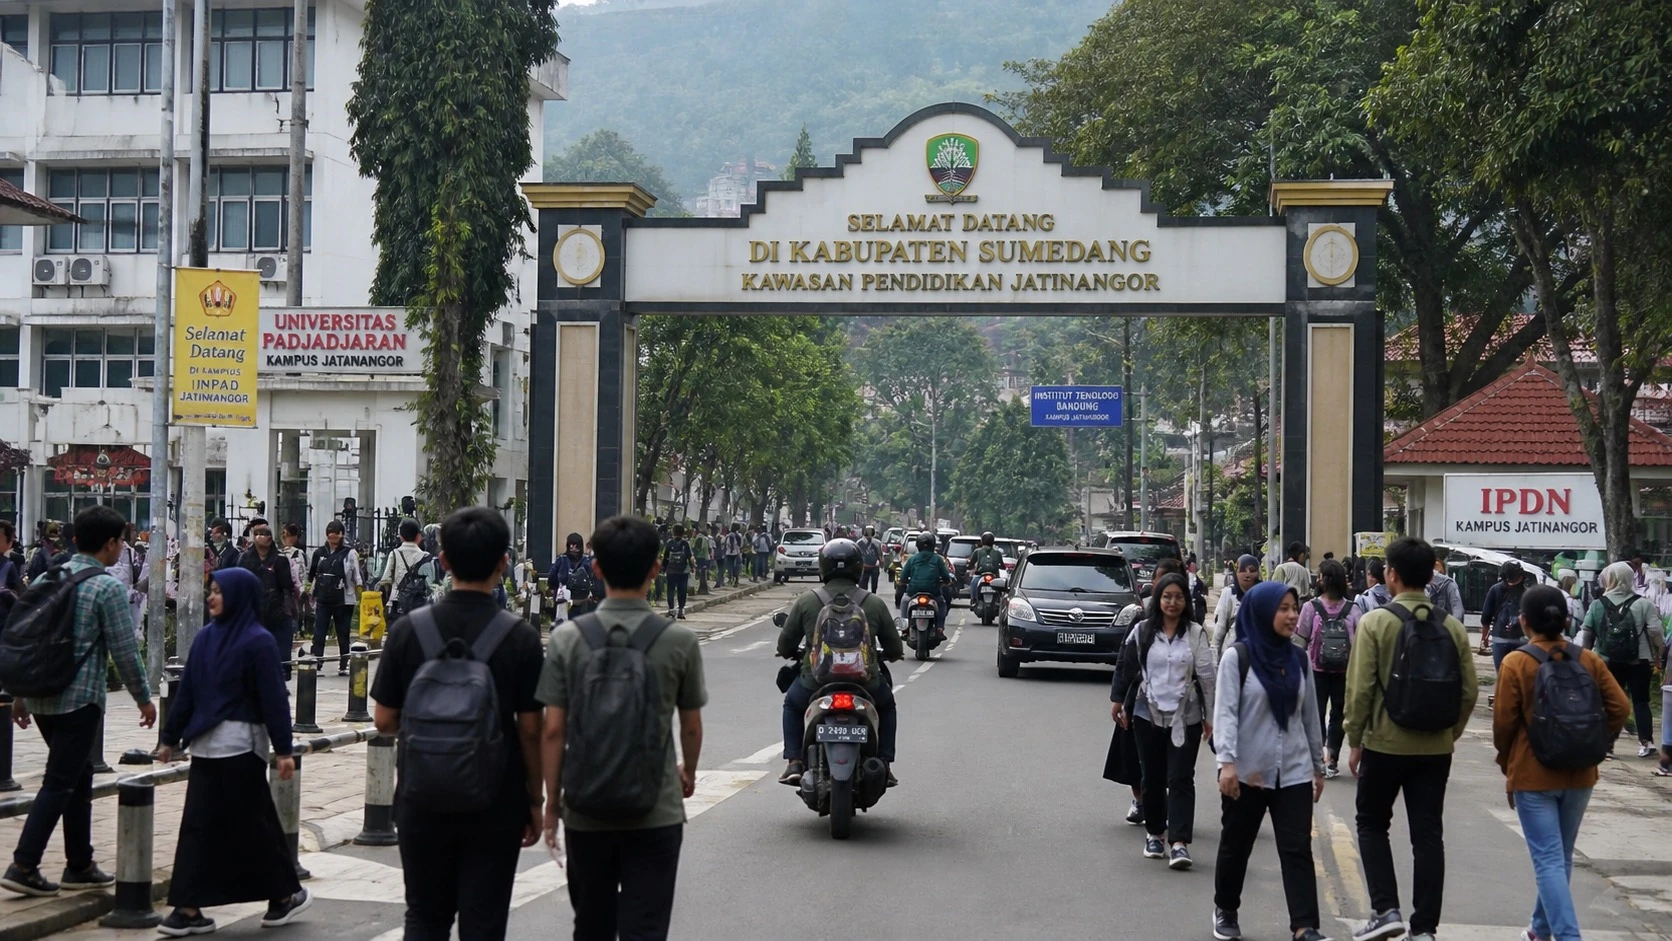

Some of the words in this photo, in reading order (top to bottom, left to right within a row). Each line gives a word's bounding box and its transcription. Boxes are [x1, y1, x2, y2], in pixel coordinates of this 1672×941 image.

[847, 214, 955, 232] SELAMAT
[962, 214, 1055, 232] DATANG
[748, 240, 779, 263] DI
[789, 240, 968, 263] KABUPATEN
[979, 240, 1152, 263] SUMEDANG
[741, 273, 853, 291] KAWASAN
[861, 273, 1003, 291] PENDIDIKAN
[1010, 273, 1161, 291] JATINANGOR
[274, 314, 397, 331] UNIVERSITAS
[185, 326, 247, 342] Selamat
[262, 333, 407, 351] PADJADJARAN
[190, 344, 245, 363] Datang
[266, 354, 318, 367] KAMPUS
[1480, 488, 1571, 515] IPDN
[1456, 520, 1511, 532] KAMPUS
[1514, 520, 1599, 533] JATINANGOR
